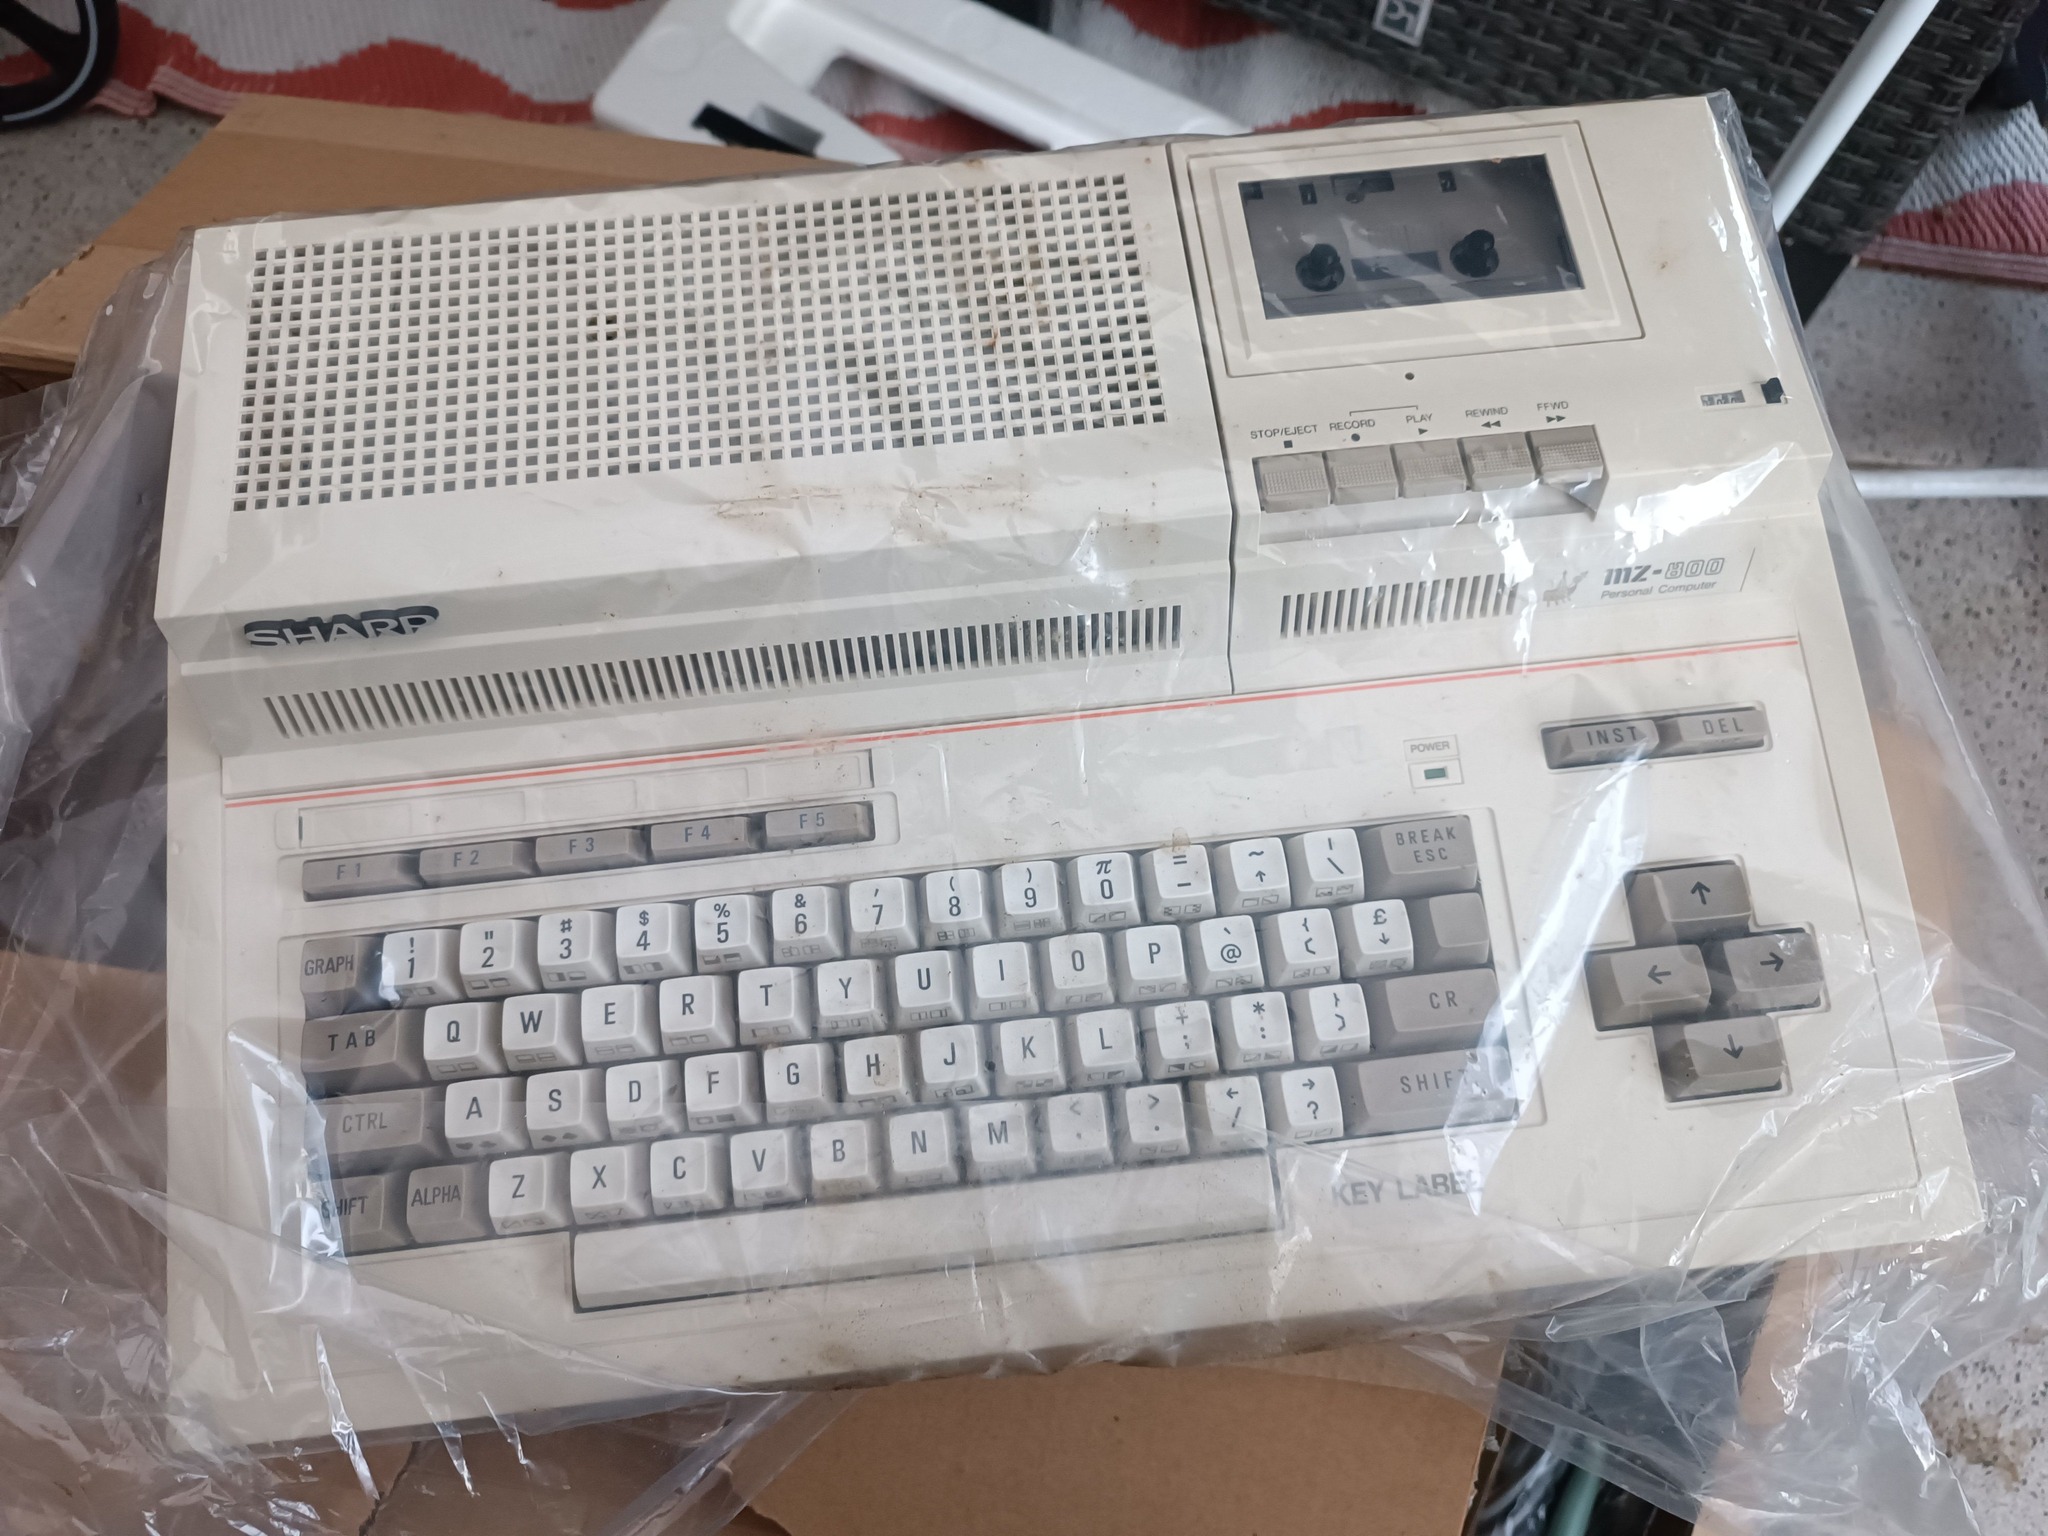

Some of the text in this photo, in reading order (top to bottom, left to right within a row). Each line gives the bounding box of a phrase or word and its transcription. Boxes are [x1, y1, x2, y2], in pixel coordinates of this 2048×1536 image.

[1465, 406, 1508, 418] REWIND
[1537, 401, 1569, 411] FFWD
[1329, 418, 1376, 431] RECORD
[1405, 413, 1433, 423] PLAY
[1250, 424, 1318, 439] STOP/EJECT
[1601, 581, 1717, 599] Personal Computer
[244, 605, 439, 648] SHARP
[1587, 726, 1639, 747] INST
[1703, 717, 1744, 736] DEL
[1410, 741, 1450, 753] POWER
[1395, 825, 1457, 847] BREAK
[1413, 847, 1448, 864] ESC
[1024, 887, 1037, 908] 9
[1100, 878, 1113, 900] 0
[713, 903, 731, 918] %
[795, 893, 806, 908] &
[949, 895, 961, 917] 8
[560, 918, 573, 933] #
[639, 910, 649, 926] $
[795, 913, 807, 935] 6
[872, 904, 884, 925] 7
[1373, 908, 1387, 925] £
[636, 930, 651, 951] 4
[716, 922, 729, 943] 5
[482, 946, 494, 968] 2
[560, 938, 572, 959] 3
[1148, 942, 1160, 964] P
[1220, 943, 1242, 964] @
[305, 954, 354, 976] GRAPH
[408, 957, 415, 978] 1
[839, 977, 852, 999] Y
[917, 967, 931, 990] U
[682, 993, 695, 1015] R
[760, 984, 773, 1006] T
[1429, 990, 1458, 1009] CR
[520, 1010, 543, 1034] W
[604, 1002, 616, 1025] E
[328, 1029, 376, 1051] TAB
[447, 1020, 460, 1042] Q
[1099, 1028, 1113, 1050] L
[943, 1042, 956, 1066] J
[1021, 1036, 1036, 1060] K
[786, 1062, 800, 1085] G
[866, 1053, 880, 1077] H
[628, 1080, 642, 1102] D
[707, 1070, 719, 1094] F
[466, 1096, 482, 1120] A
[548, 1089, 562, 1112] S
[1307, 1100, 1319, 1119] ?
[342, 1113, 388, 1134] CTRL
[988, 1120, 1009, 1145] M
[832, 1139, 845, 1162] B
[911, 1130, 928, 1154] N
[673, 1156, 687, 1179] C
[751, 1148, 766, 1172] V
[512, 1174, 525, 1198] Z
[591, 1165, 607, 1189] X
[411, 1184, 462, 1208] ALPHA
[1332, 1180, 1384, 1207] KEY
